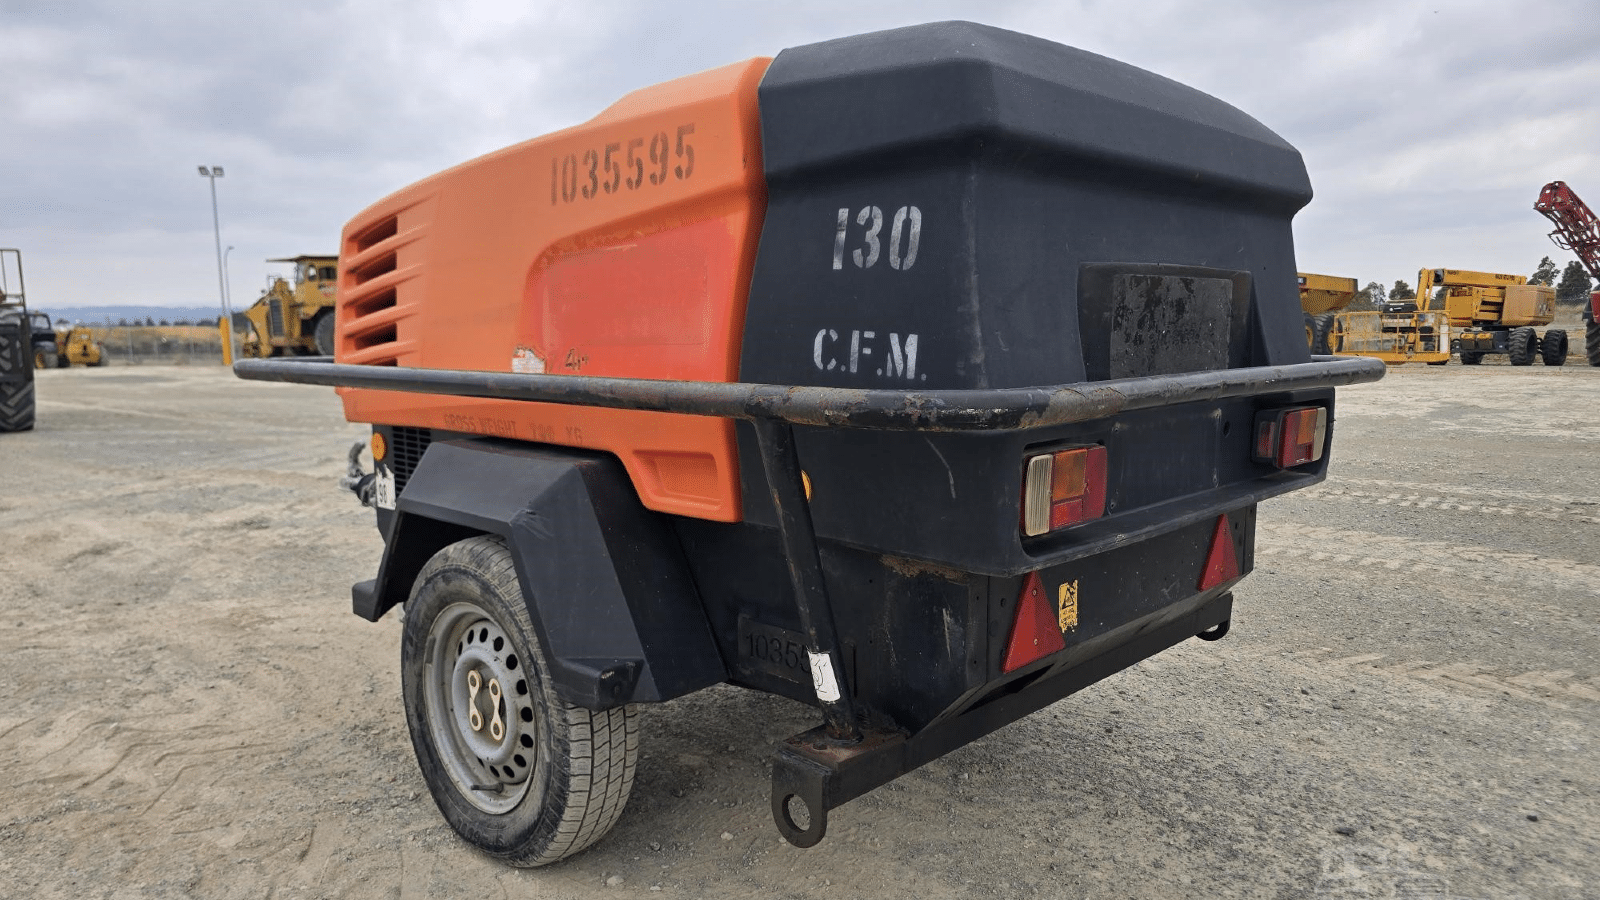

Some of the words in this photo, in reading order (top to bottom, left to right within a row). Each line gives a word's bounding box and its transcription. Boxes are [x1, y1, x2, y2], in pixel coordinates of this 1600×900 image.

[550, 122, 696, 207] 1035595
[832, 205, 923, 271] 130
[813, 328, 927, 381] C.F.M.
